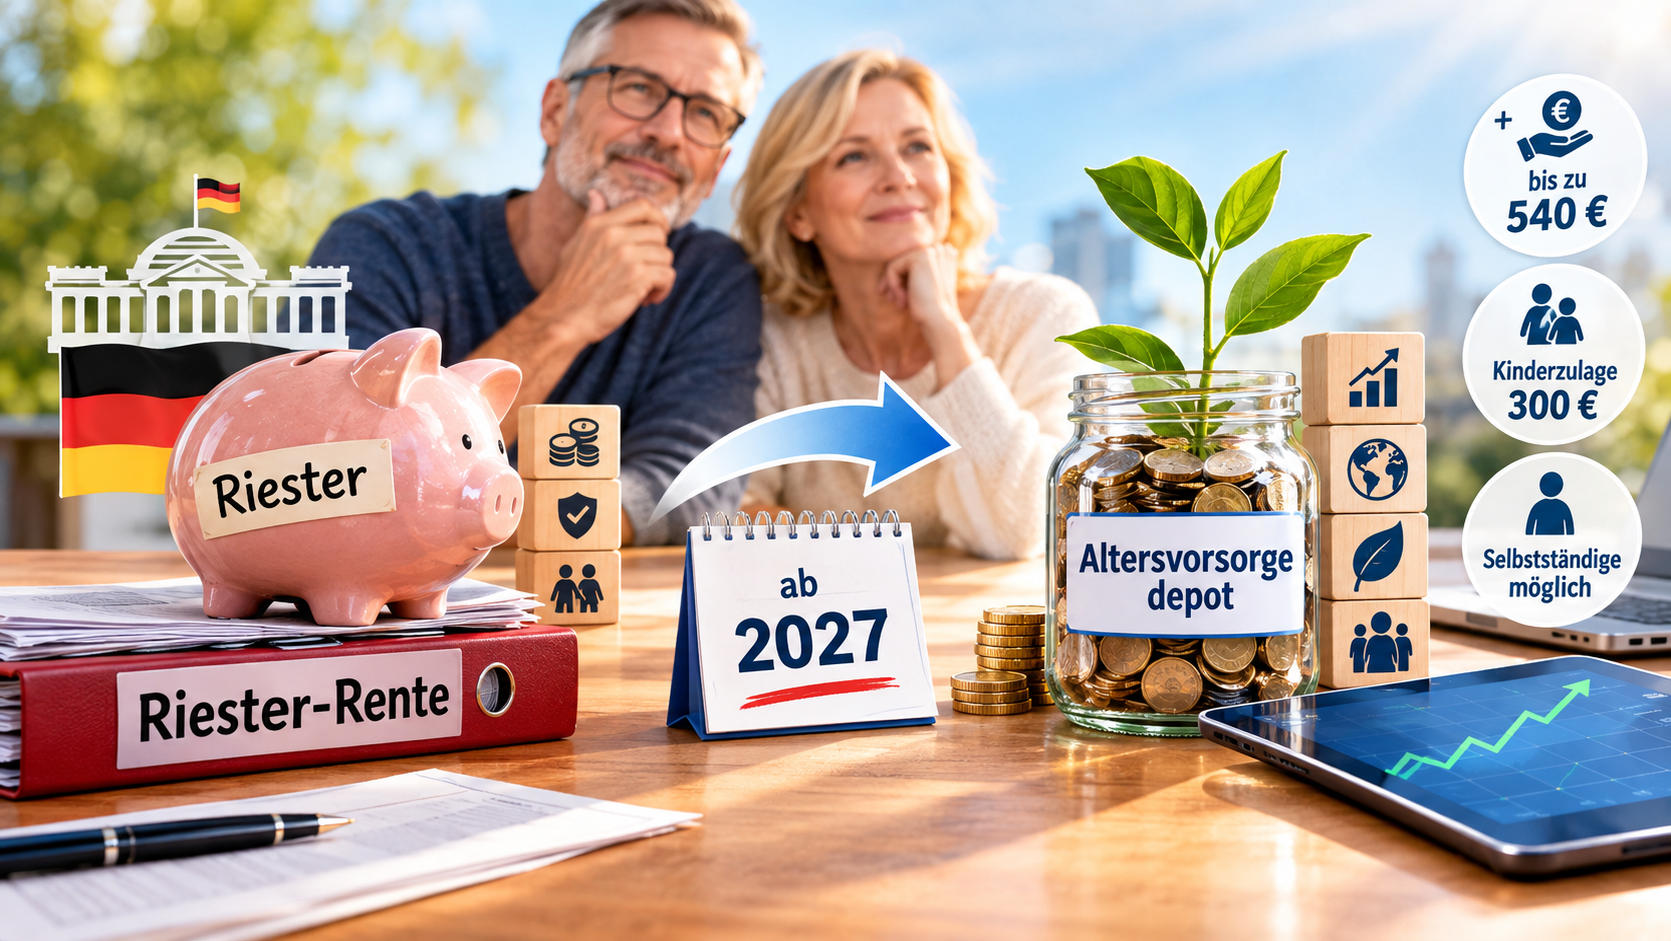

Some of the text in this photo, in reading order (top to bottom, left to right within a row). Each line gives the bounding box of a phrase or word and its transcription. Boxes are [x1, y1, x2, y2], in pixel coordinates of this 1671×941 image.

[212, 461, 367, 519] Riester
[780, 567, 818, 599] ab
[1078, 541, 1294, 581] Altersvorsorge
[1147, 578, 1235, 619] depot
[735, 608, 888, 674] 2027
[139, 676, 450, 743] Riester-Rente
